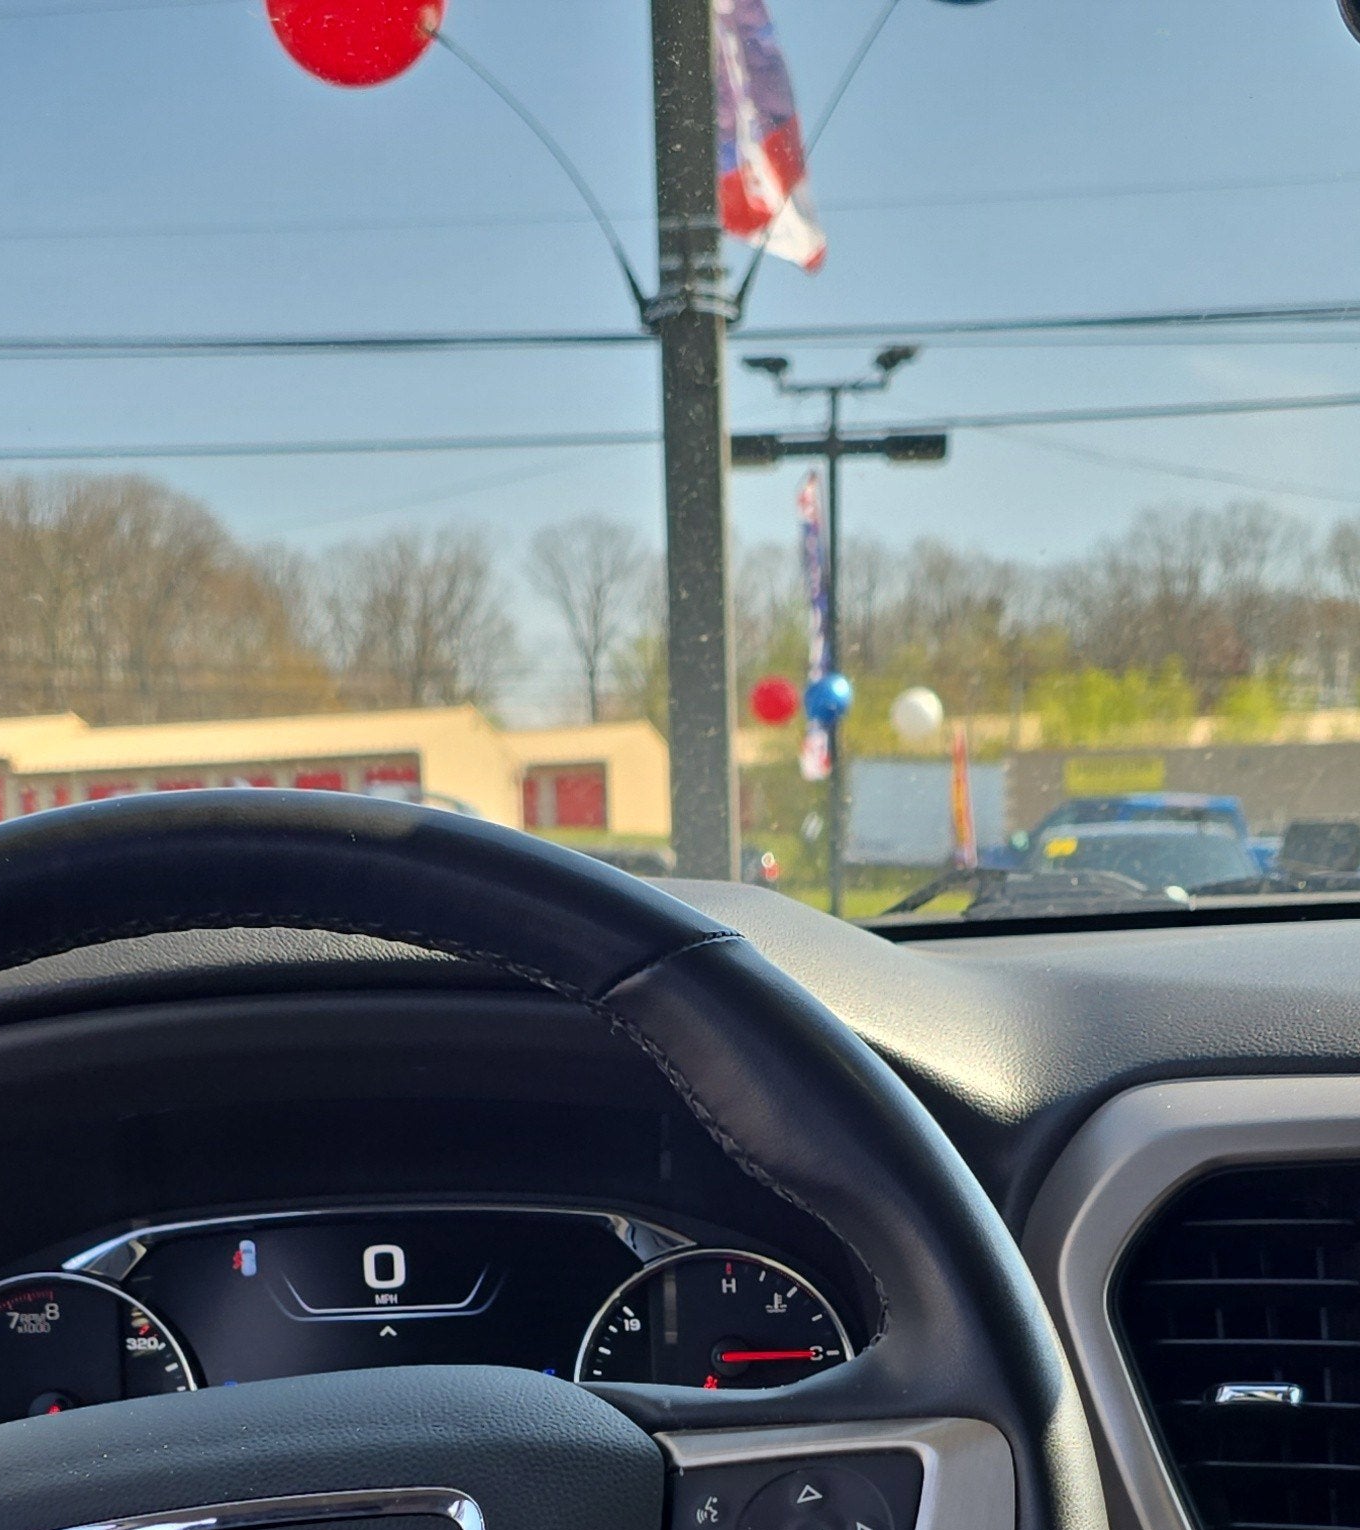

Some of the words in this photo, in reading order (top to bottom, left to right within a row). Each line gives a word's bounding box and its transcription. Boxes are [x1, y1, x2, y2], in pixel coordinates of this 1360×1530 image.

[363, 1244, 406, 1289] 0
[721, 1278, 737, 1293] H
[374, 1293, 398, 1306] MPH
[45, 1303, 60, 1320] 8
[6, 1312, 19, 1329] 7
[623, 1319, 641, 1332] 19
